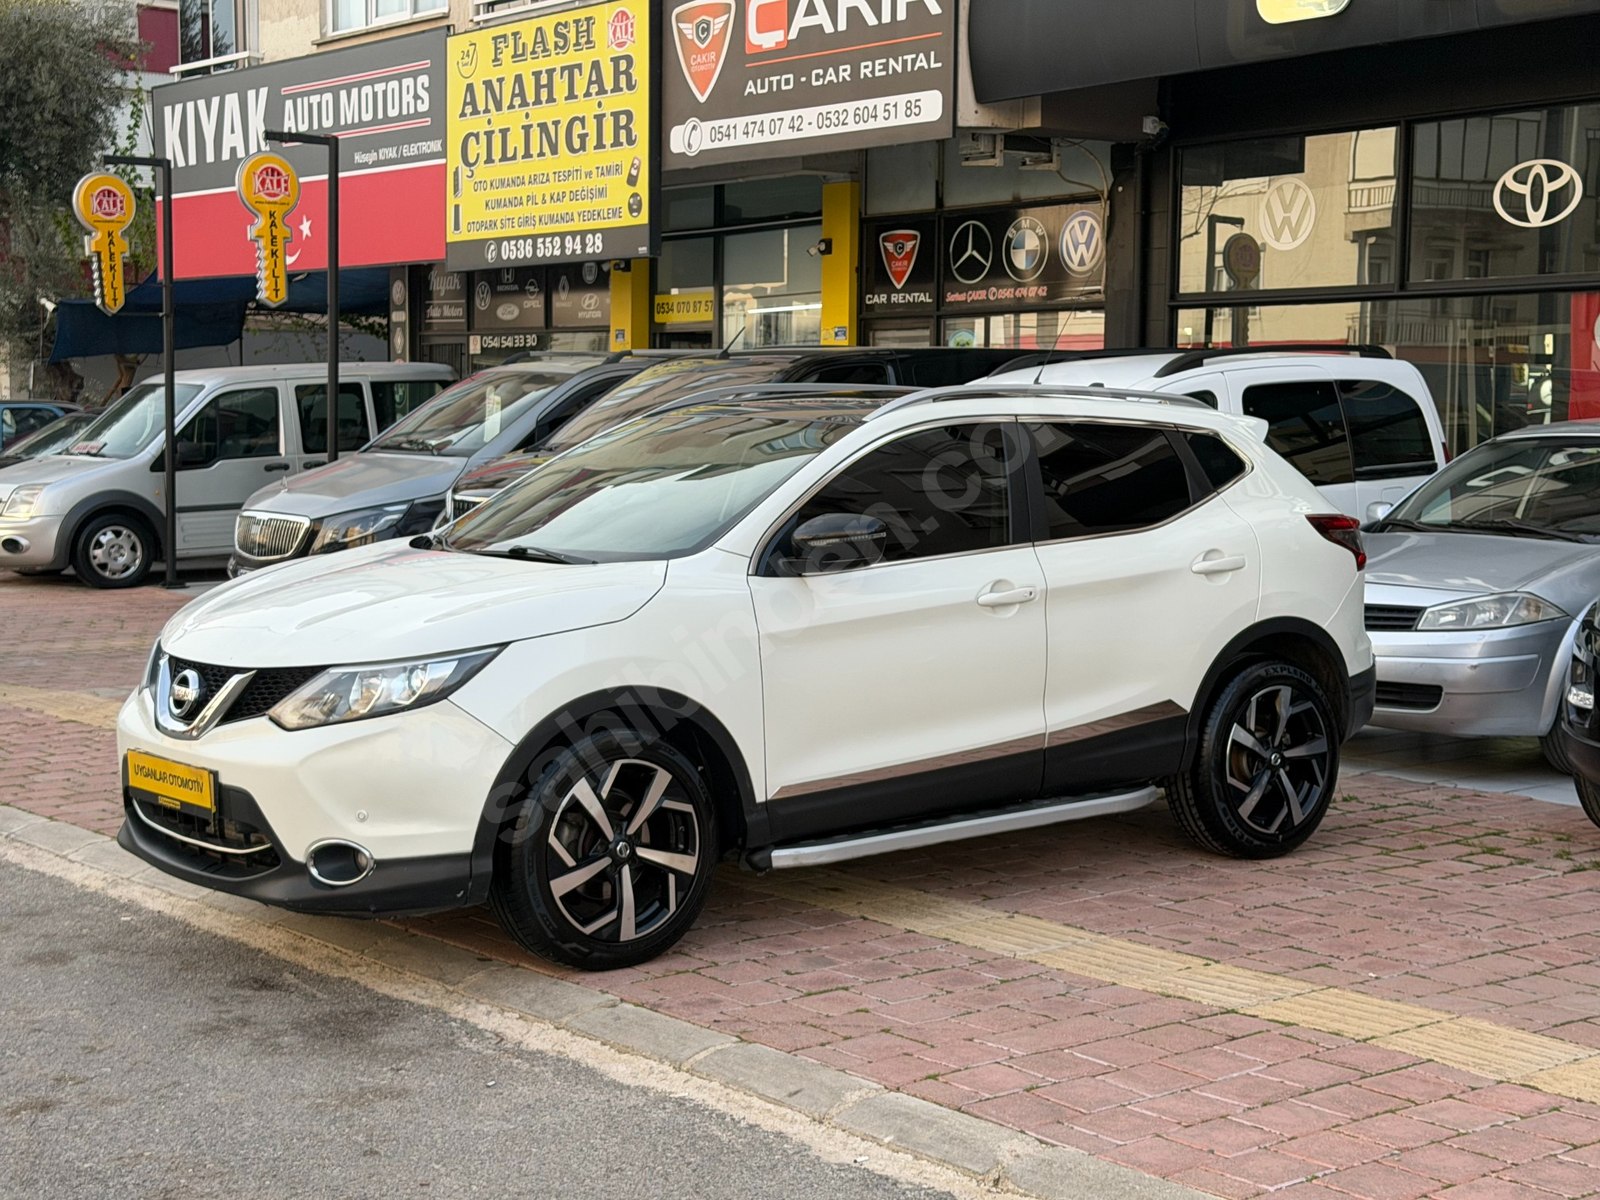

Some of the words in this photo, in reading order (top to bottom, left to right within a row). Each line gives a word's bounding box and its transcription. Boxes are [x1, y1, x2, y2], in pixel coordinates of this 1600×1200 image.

[491, 16, 596, 67] FLASH
[459, 53, 637, 119] ANAHTAR
[744, 73, 794, 96] AUTO
[811, 64, 851, 87] CAR
[860, 51, 942, 79] RENTAL
[164, 87, 270, 169] KIYAK
[283, 92, 334, 133] AUTO
[340, 74, 429, 127] MOTORS
[710, 123, 738, 143] 0541
[742, 120, 765, 138] 474
[769, 117, 784, 135] 07
[788, 115, 804, 133] 42
[817, 108, 849, 129] 0532
[853, 105, 879, 125] 604
[883, 101, 899, 121] 51
[905, 98, 922, 118] 85
[460, 100, 637, 178] ÇİLİNGİR
[253, 171, 291, 197] KALE
[473, 181, 488, 192] OTO
[490, 176, 525, 190] KUMANDA
[528, 173, 551, 186] ARIZA
[553, 166, 582, 182] TESPİTİ
[584, 169, 593, 179] ve
[595, 160, 623, 178] TAMİRİ
[91, 193, 126, 216] KALE
[485, 196, 523, 211] KUMANDA
[526, 191, 539, 206] PİL
[541, 194, 547, 204] &
[550, 191, 567, 203] KAP
[569, 184, 608, 203] DEĞİŞİMİ
[467, 219, 499, 233] OTOPARK
[500, 215, 515, 230] SİTE
[517, 213, 536, 229] GİRİŞ
[538, 212, 575, 226] KUMANDA
[577, 207, 623, 223] YEDEKLEME
[501, 238, 533, 260] 0536
[536, 236, 561, 257] 552
[565, 234, 582, 255] 94
[585, 233, 603, 253] 28
[523, 300, 541, 309] OPEL
[656, 301, 674, 315] 0534
[677, 301, 690, 313] 070
[693, 300, 702, 312] 87
[704, 299, 714, 312] 57
[866, 294, 887, 304] CAR
[891, 292, 933, 303] RENTAL
[514, 335, 525, 347] 33
[525, 333, 537, 347] 30
